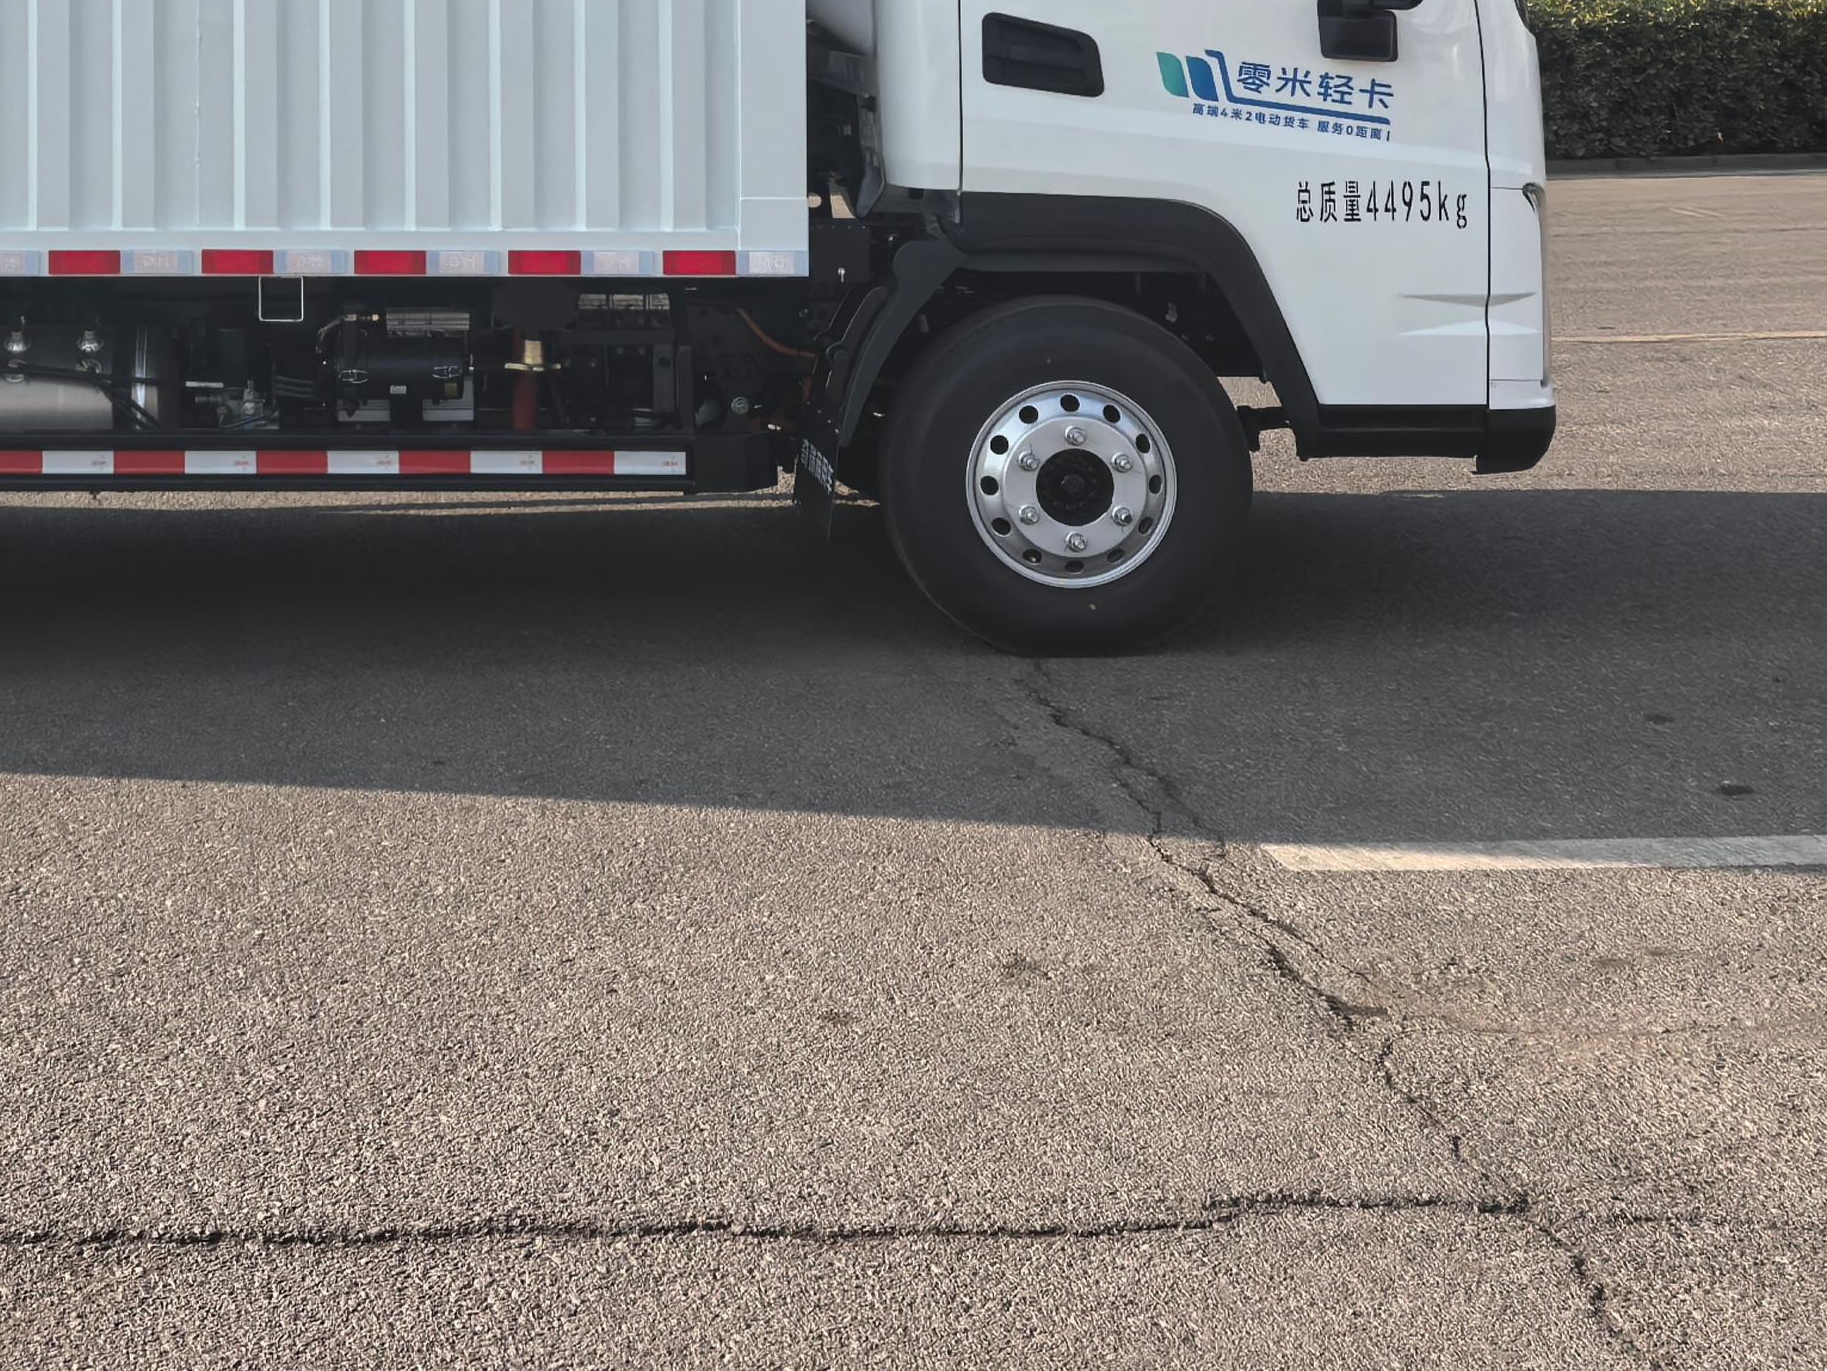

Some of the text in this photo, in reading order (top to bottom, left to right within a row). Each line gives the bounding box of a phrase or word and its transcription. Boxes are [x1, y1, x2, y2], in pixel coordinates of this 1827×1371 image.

[1237, 61, 1394, 109] 零米轻卡
[1296, 180, 1468, 229] 总质量4495kg
